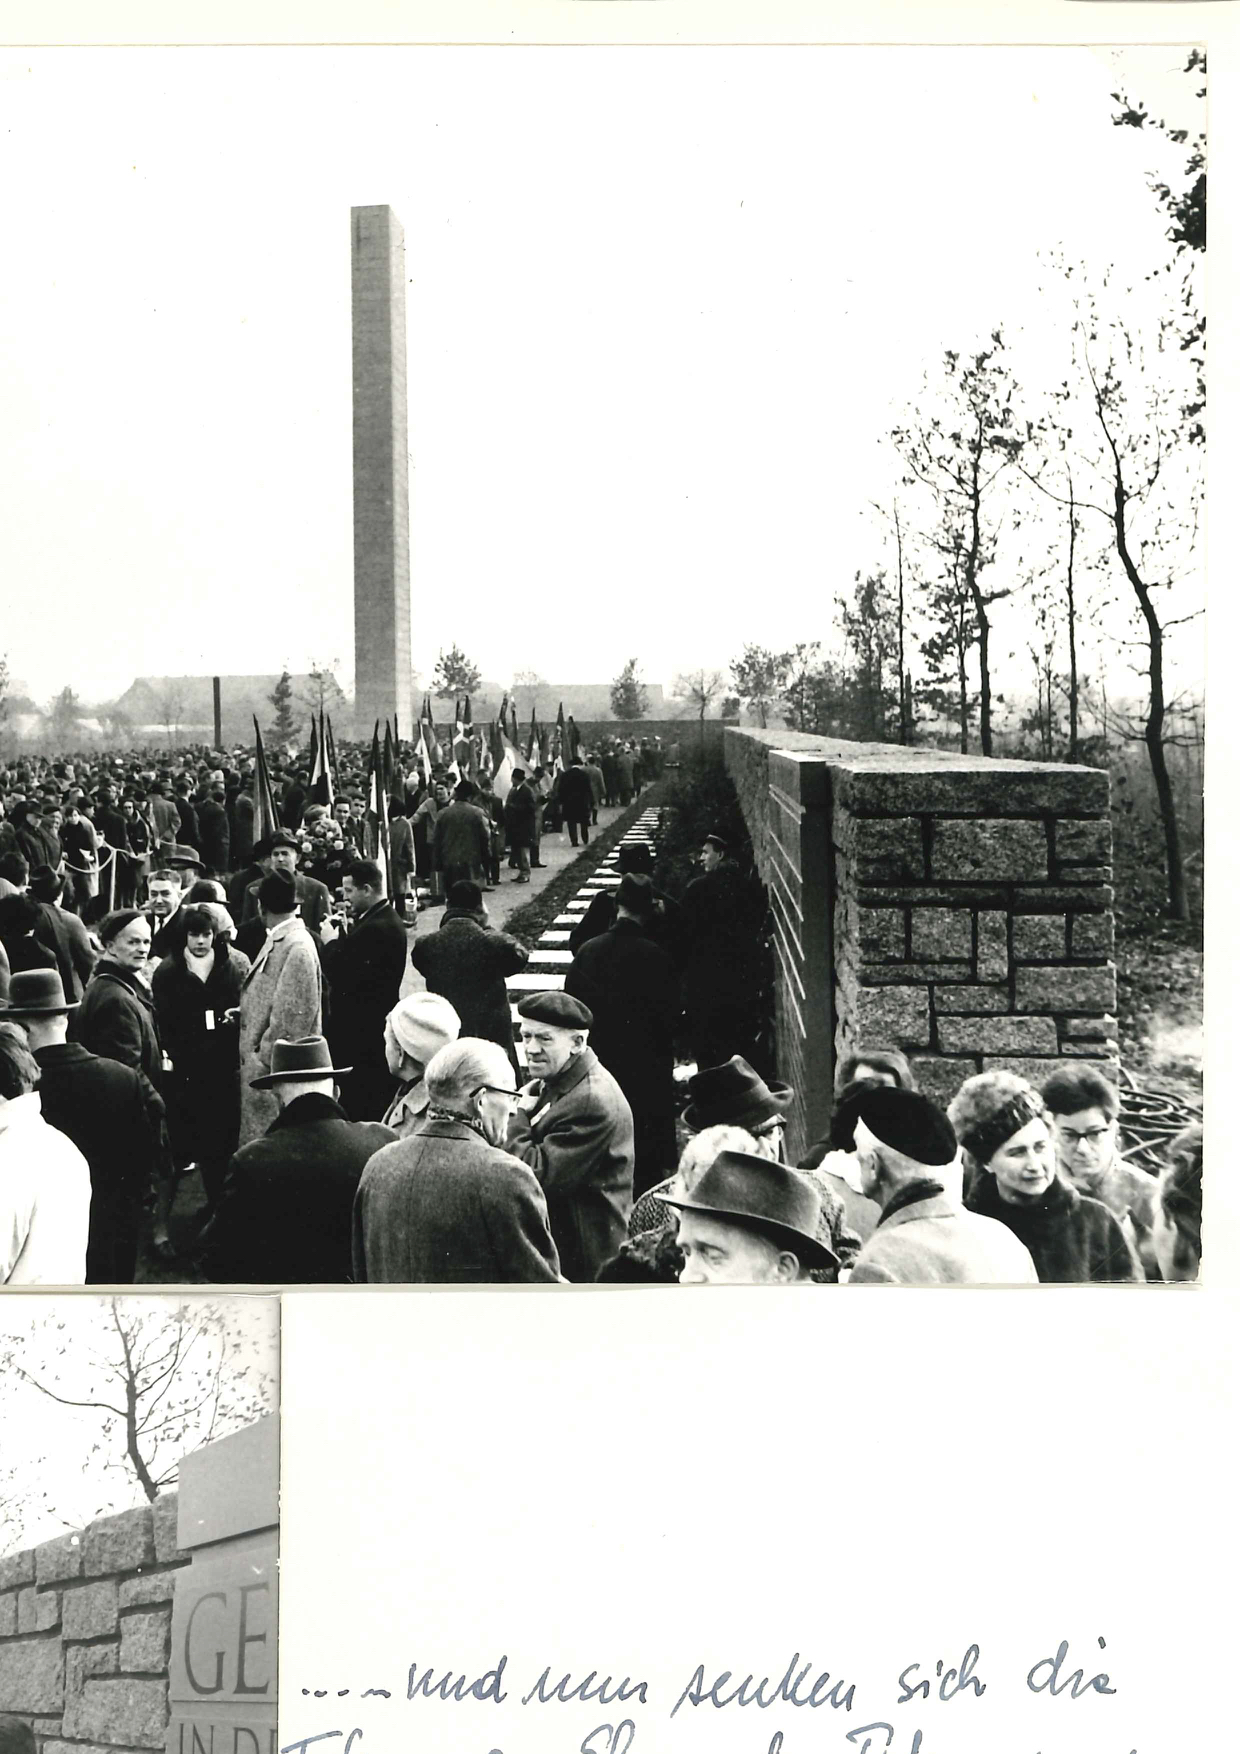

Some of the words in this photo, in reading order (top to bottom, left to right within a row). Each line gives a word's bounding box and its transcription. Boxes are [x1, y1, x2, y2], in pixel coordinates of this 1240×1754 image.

[520, 1664, 649, 1707] nun
[669, 1651, 857, 1719] senken
[896, 1643, 987, 1703] sich
[1025, 1634, 1118, 1701] die
